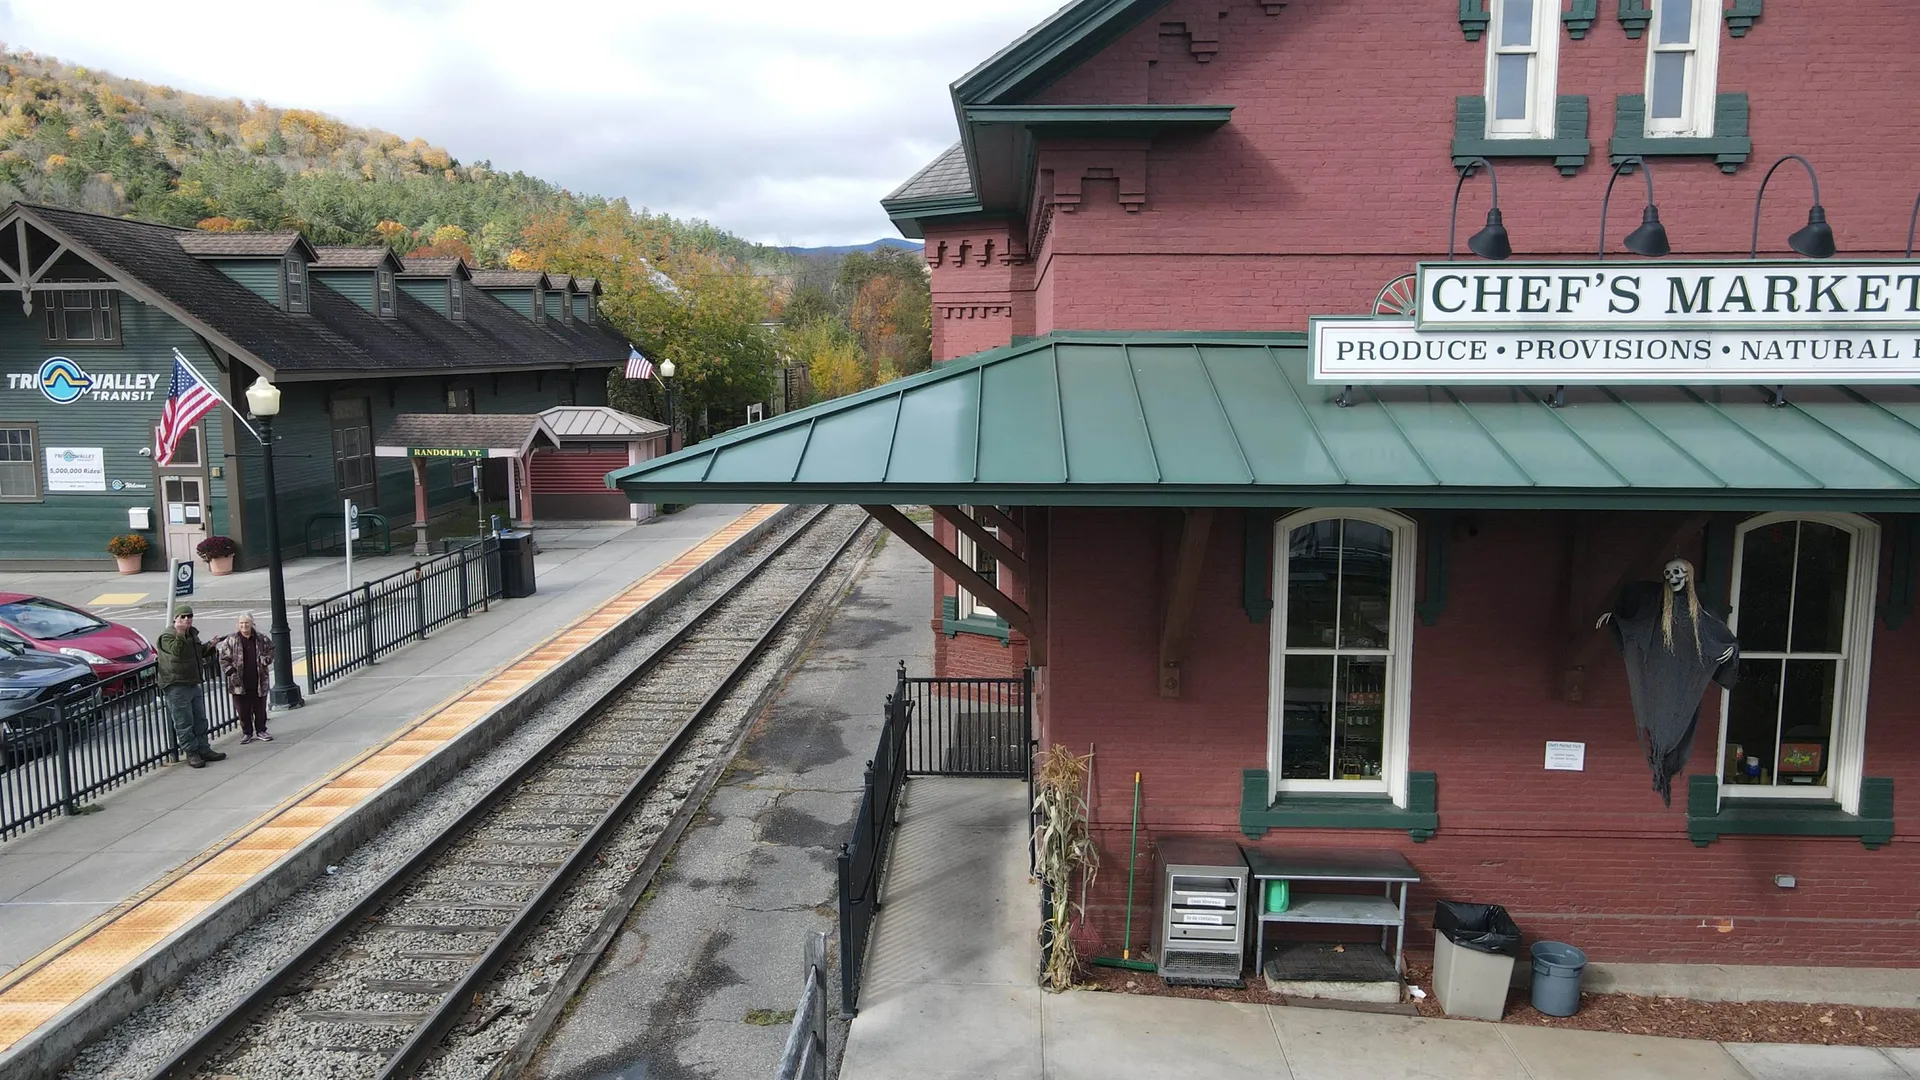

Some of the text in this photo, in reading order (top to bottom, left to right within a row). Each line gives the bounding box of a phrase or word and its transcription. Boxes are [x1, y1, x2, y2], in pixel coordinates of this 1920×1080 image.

[1432, 273, 1920, 313] CHEF'S MARKET
[1336, 340, 1487, 361] PRODUCE
[1515, 339, 1712, 360] PROVISIONS
[1740, 339, 1900, 360] NATURAL
[7, 373, 160, 389] TRI VALLEY
[92, 391, 154, 401] TRANSIT
[414, 448, 482, 457] RANDOLPH, VT.
